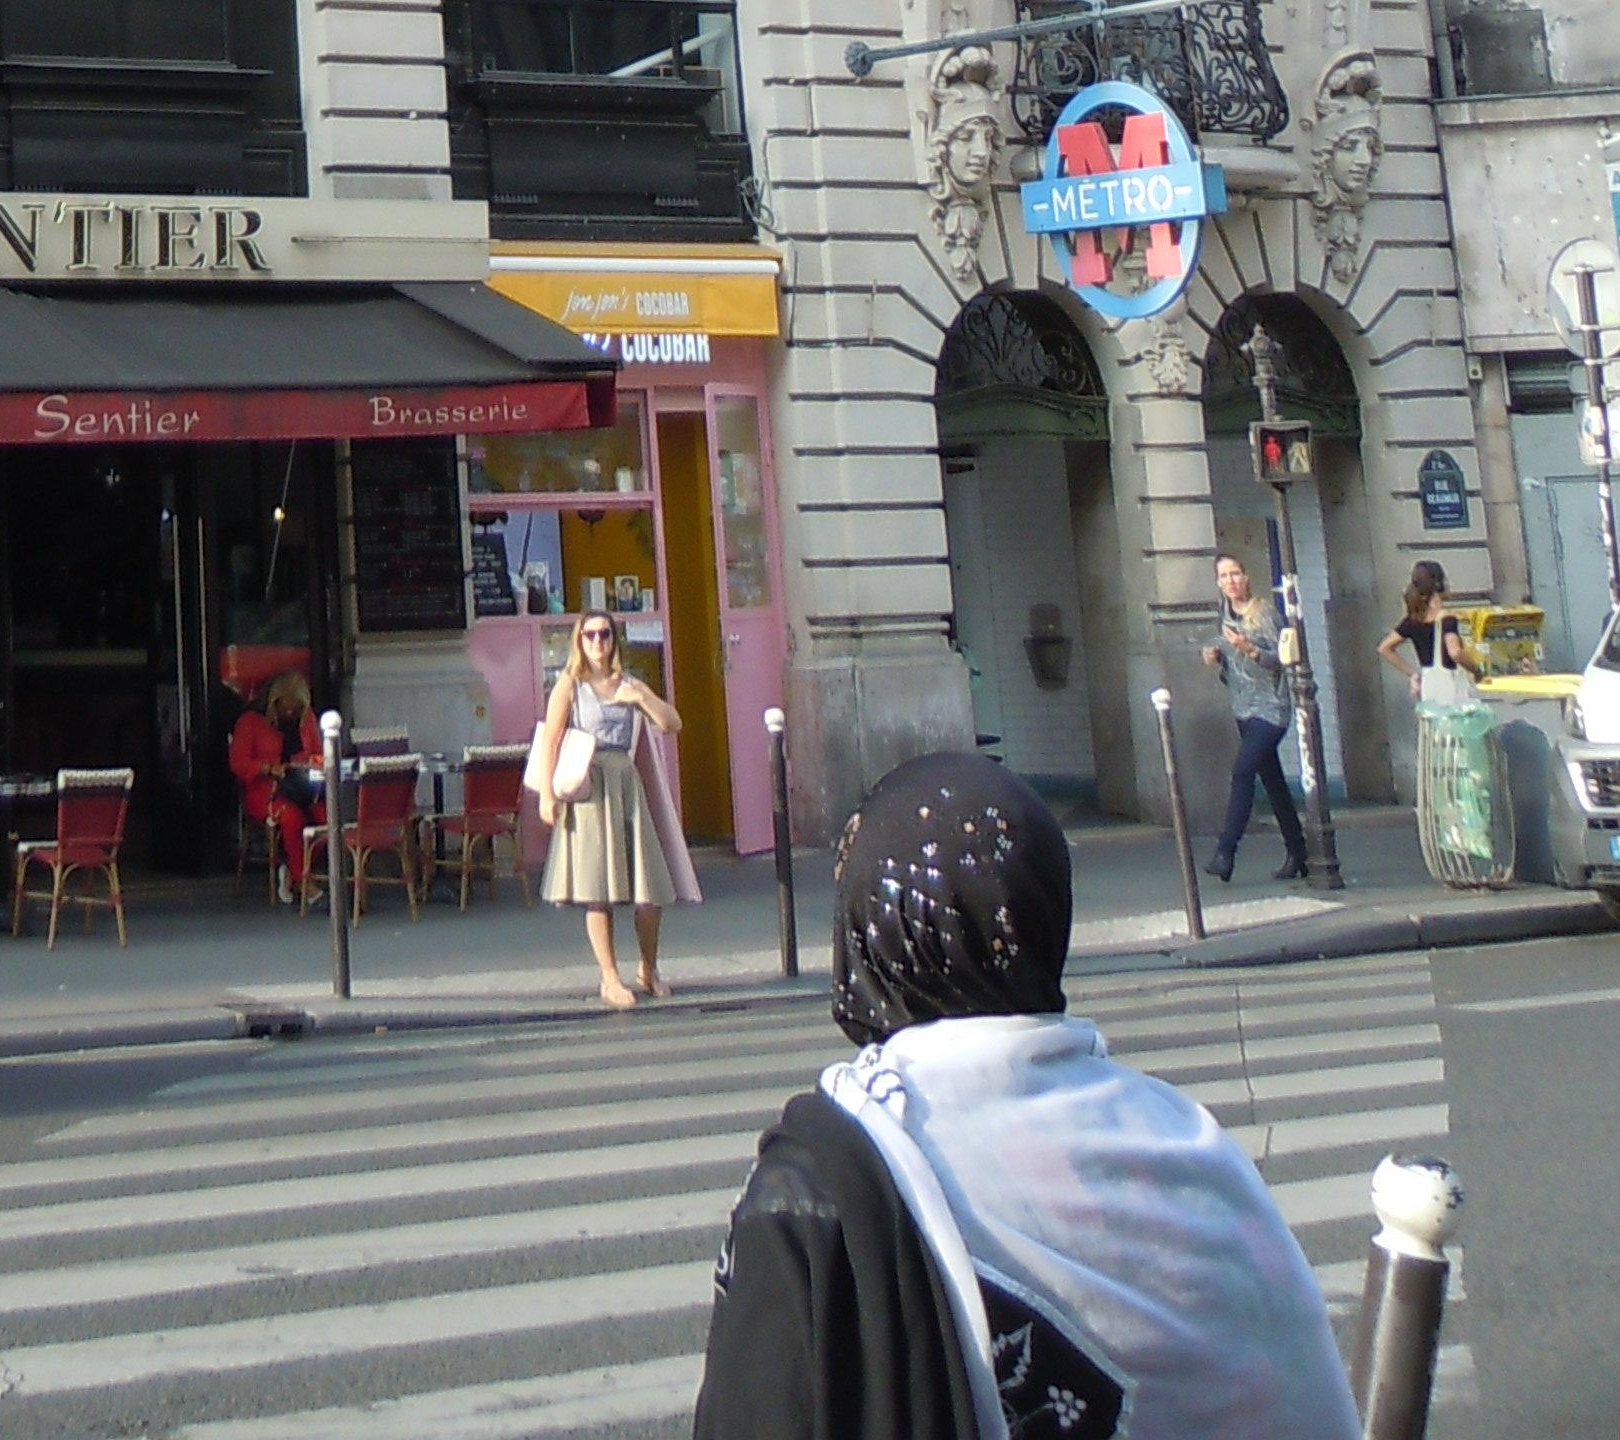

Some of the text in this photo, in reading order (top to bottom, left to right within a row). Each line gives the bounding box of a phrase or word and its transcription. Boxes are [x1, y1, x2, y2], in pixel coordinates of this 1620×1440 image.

[635, 291, 689, 316] COCOBAR
[34, 394, 201, 438] Sentier
[368, 395, 529, 426] Brasserie
